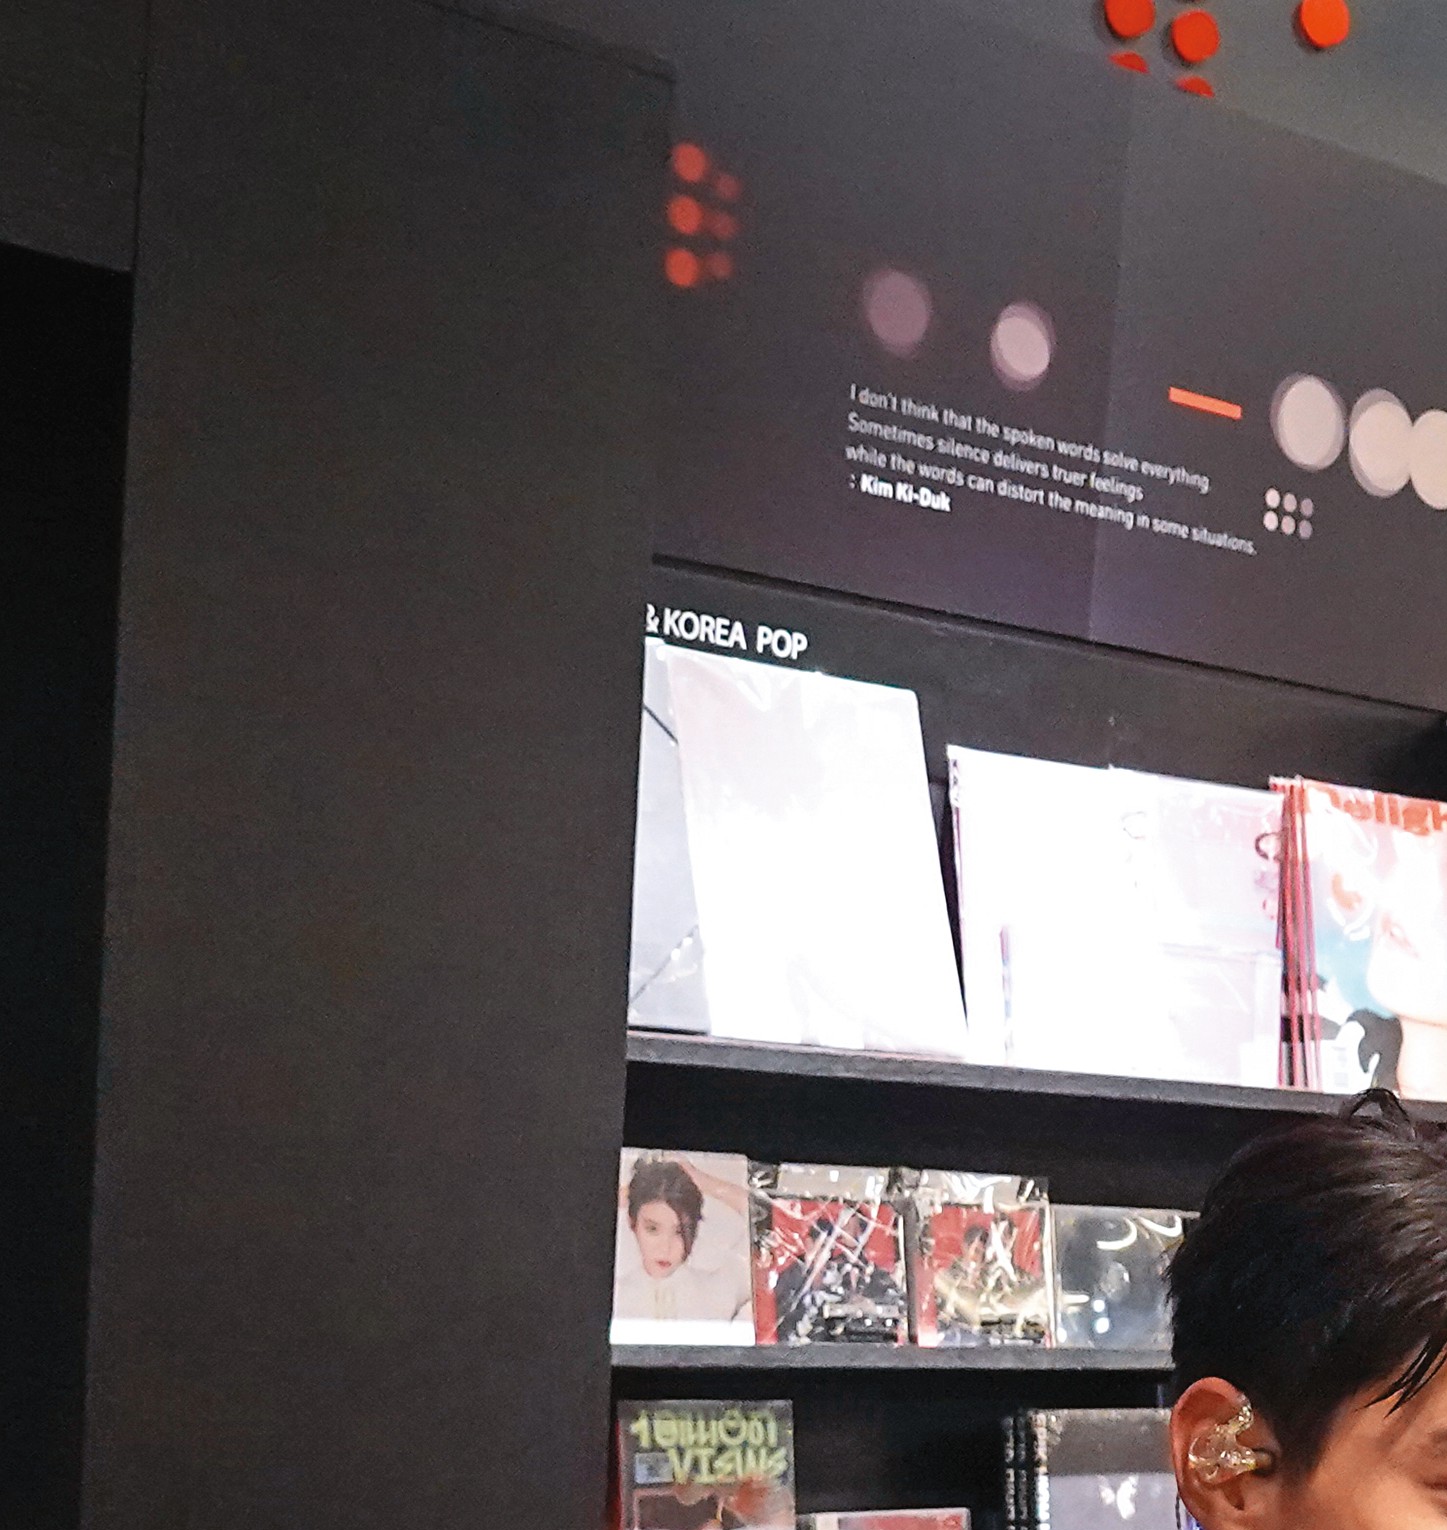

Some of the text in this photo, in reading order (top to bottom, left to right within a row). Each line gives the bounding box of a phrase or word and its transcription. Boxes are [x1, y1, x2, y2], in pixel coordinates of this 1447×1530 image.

[848, 411, 935, 450] Sometimes
[936, 437, 990, 464] silence
[992, 449, 1049, 479] delivers
[1052, 464, 1087, 487] truer
[858, 387, 898, 412] don't
[901, 398, 940, 423] think
[942, 407, 973, 431] that
[975, 416, 1000, 438] the
[1002, 425, 1054, 451] spoken
[1056, 443, 1101, 463] words
[1103, 450, 1139, 472] solve
[845, 444, 888, 468] while
[890, 452, 916, 475] the
[918, 462, 964, 486] words
[967, 473, 994, 494] can
[997, 478, 1044, 505] distort
[1047, 490, 1072, 513] the
[1074, 499, 1134, 530] meaning
[1136, 513, 1150, 529] in
[1152, 518, 1190, 539] some
[860, 473, 952, 512] Kim Ki-Duk
[663, 607, 748, 651] KOREA
[756, 625, 808, 660] POP
